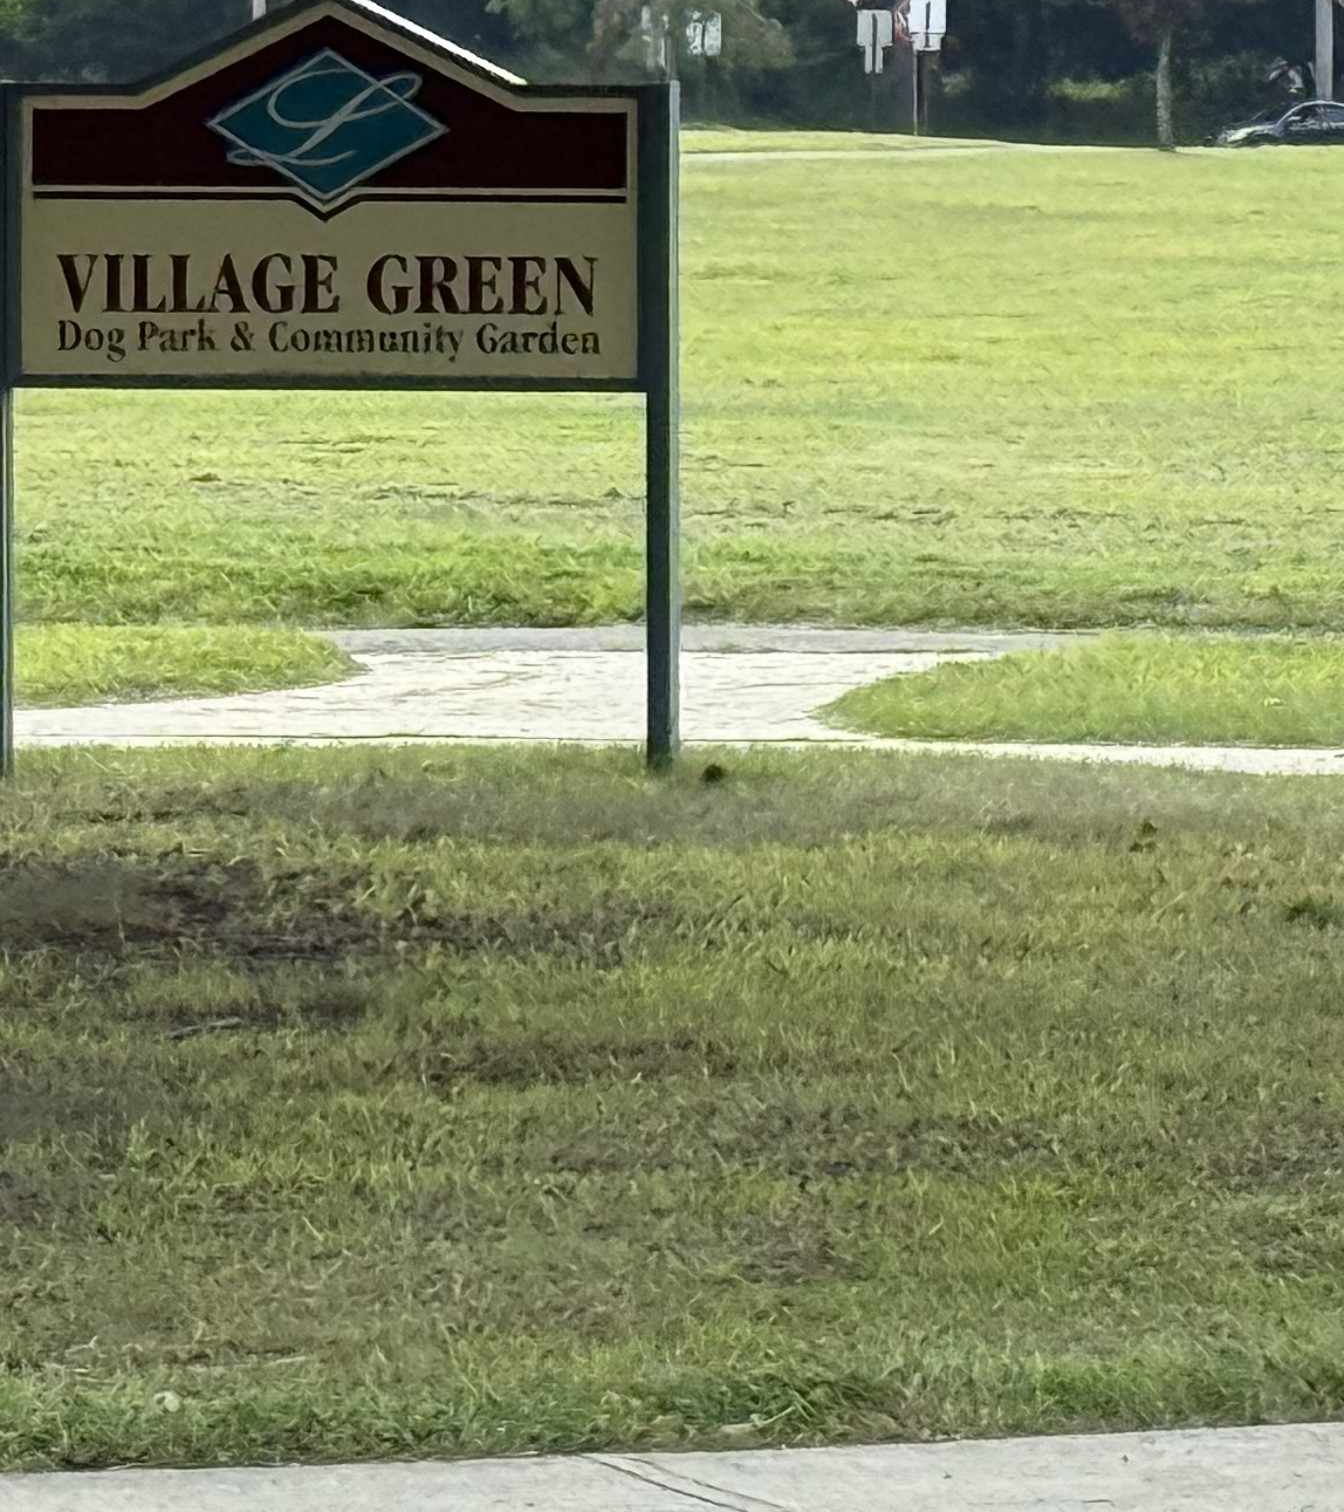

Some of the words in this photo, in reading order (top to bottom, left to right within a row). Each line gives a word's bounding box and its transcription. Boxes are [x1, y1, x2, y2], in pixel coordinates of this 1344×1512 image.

[57, 253, 341, 315] VILLAGE
[366, 253, 597, 316] GREEN
[57, 320, 126, 362] Dog
[137, 319, 219, 353] Park
[230, 322, 254, 352] &
[269, 321, 464, 363] Community
[476, 320, 601, 355] Garden
